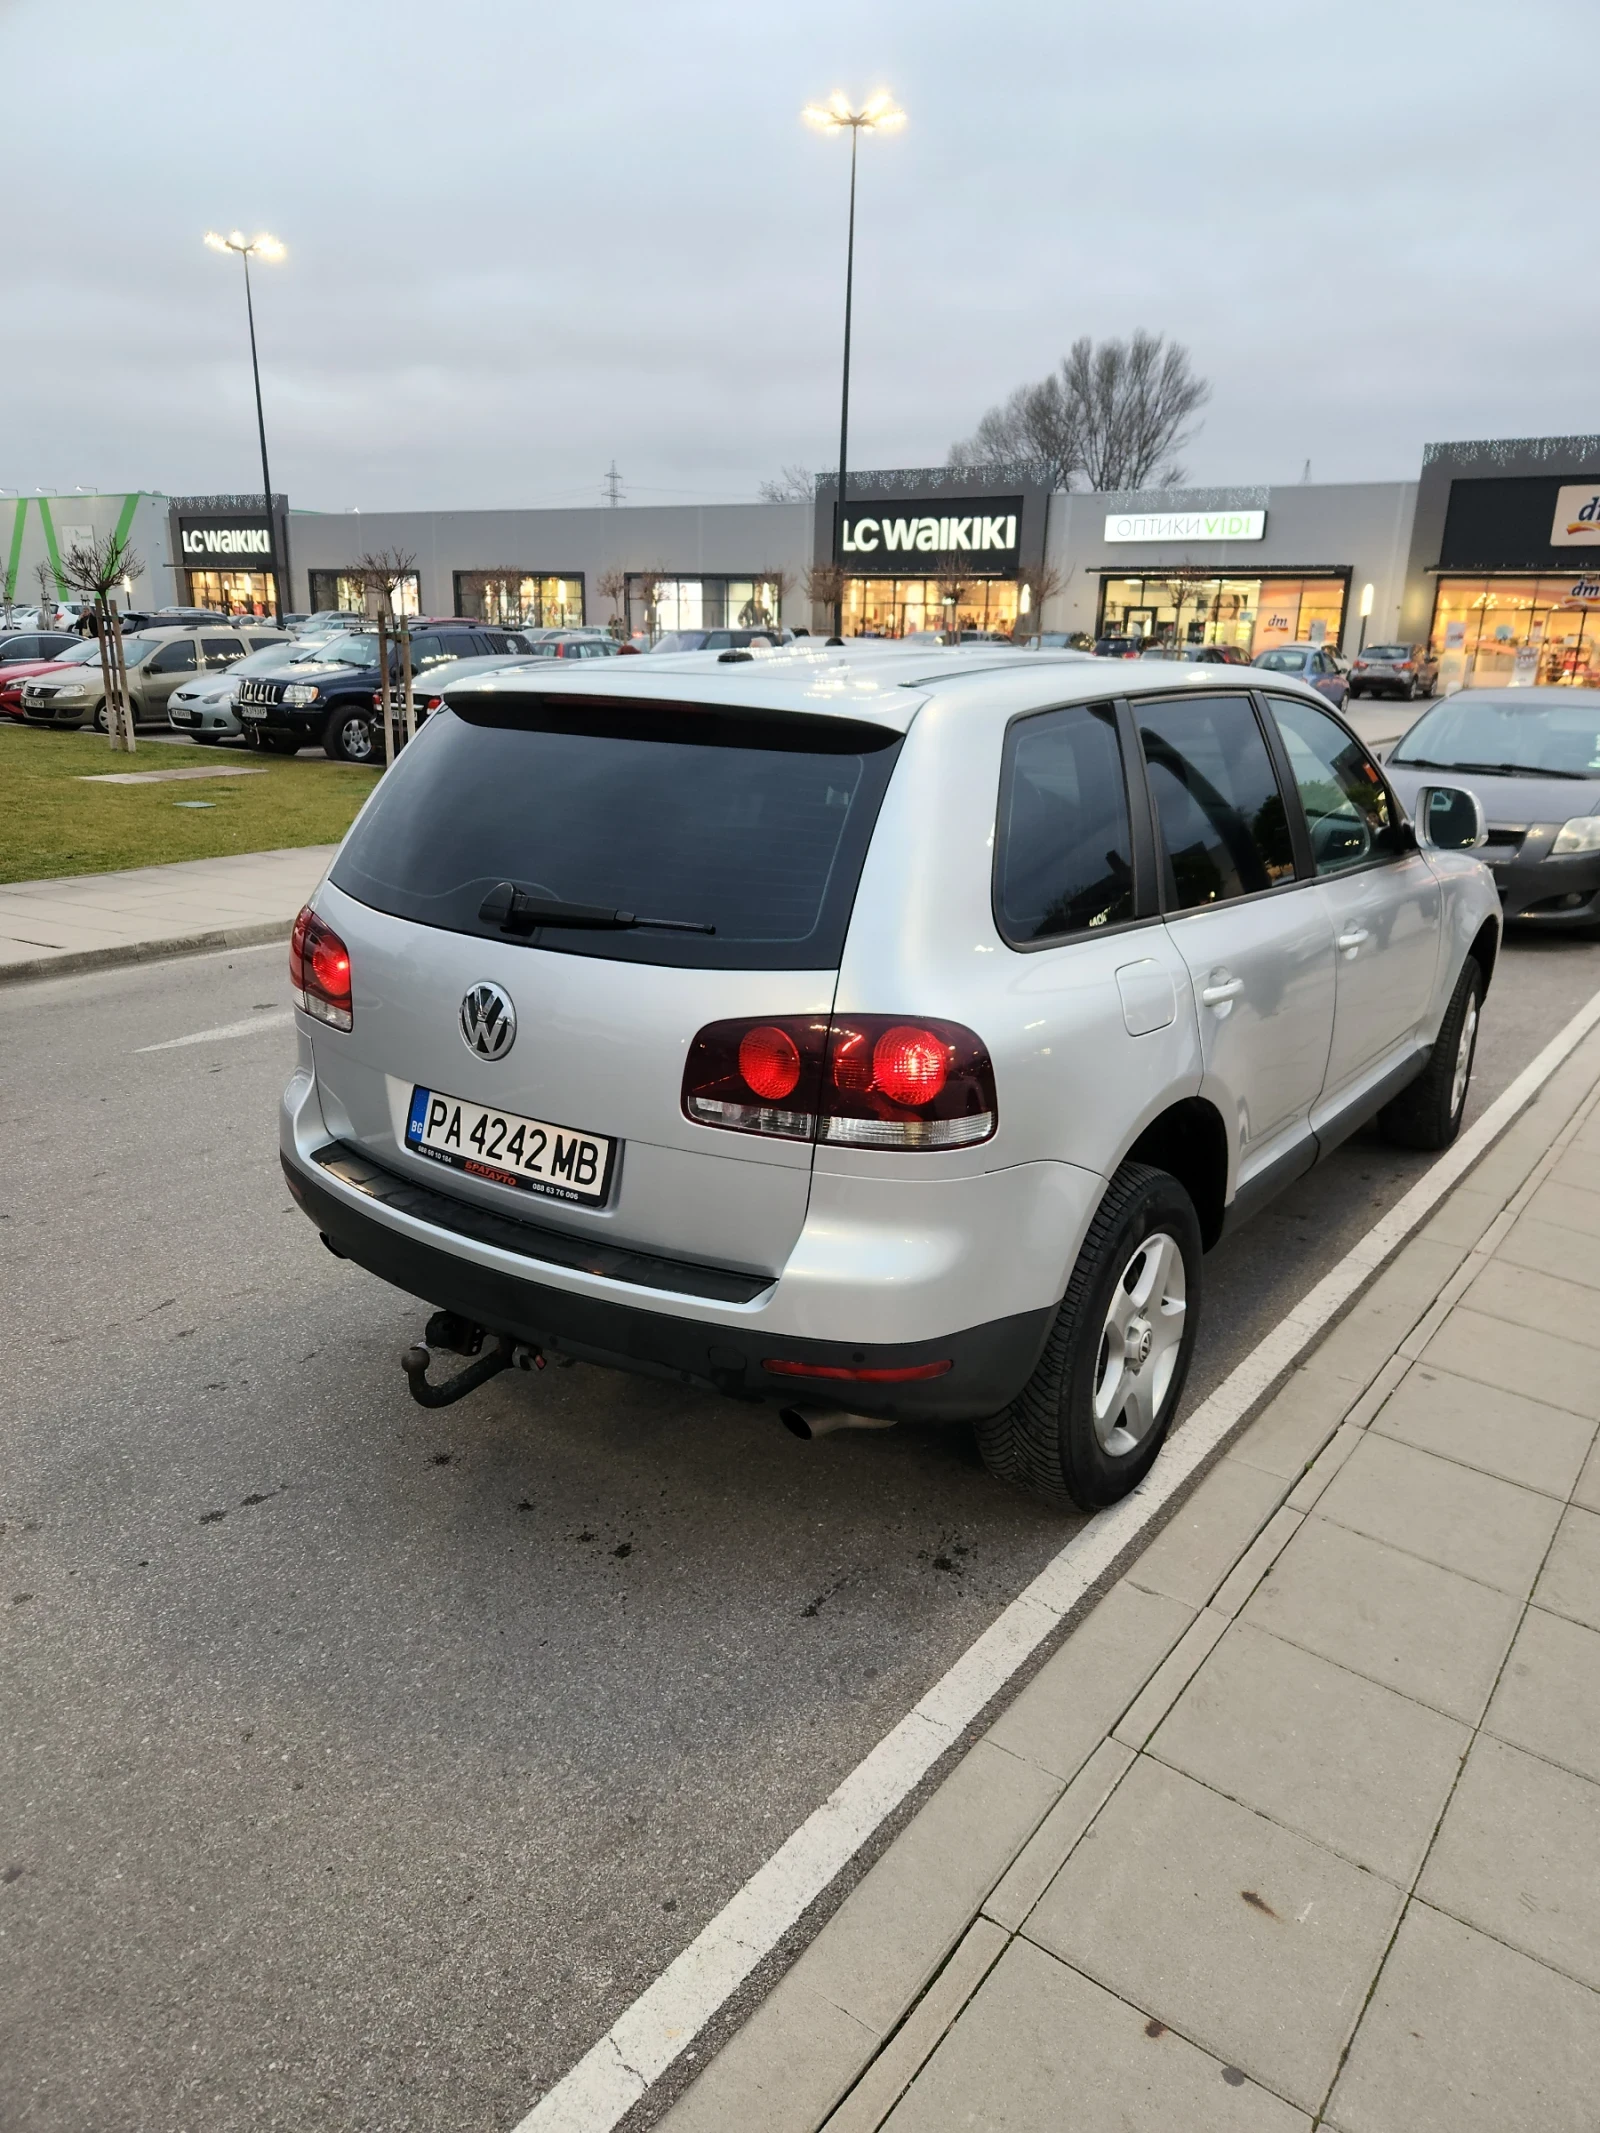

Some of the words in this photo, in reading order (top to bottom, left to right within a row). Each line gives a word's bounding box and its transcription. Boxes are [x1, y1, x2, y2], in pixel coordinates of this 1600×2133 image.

[1578, 496, 1600, 521] d
[843, 518, 880, 552] LC
[1116, 517, 1200, 537] ОПТИКИ
[1204, 516, 1251, 535] VIDI
[182, 529, 204, 553] LC
[1571, 580, 1600, 597] dm
[1268, 614, 1288, 627] dm
[411, 1120, 423, 1134] BG
